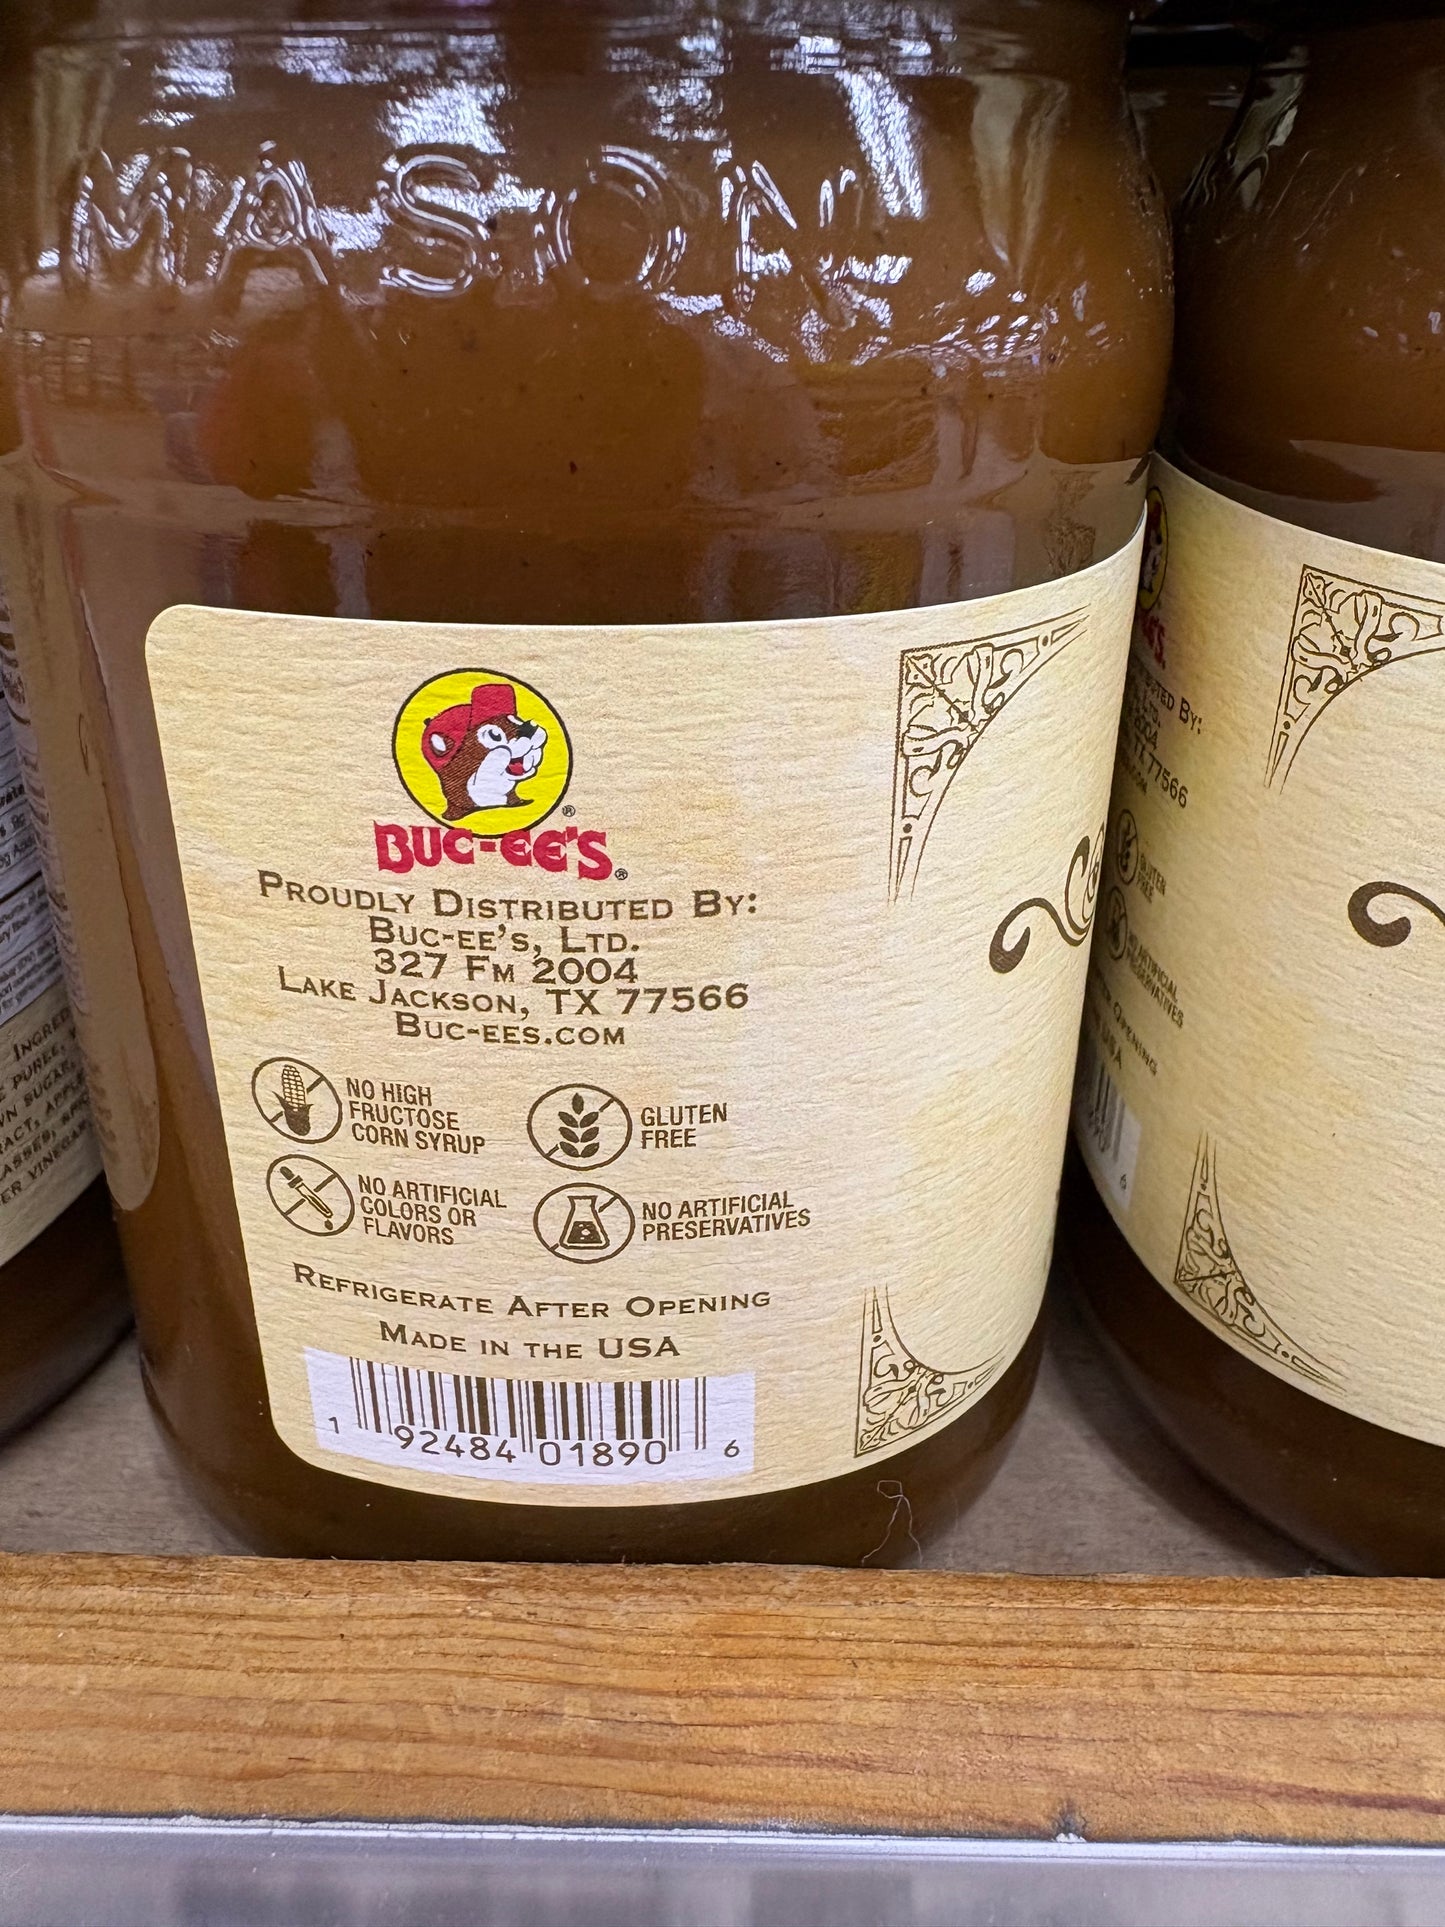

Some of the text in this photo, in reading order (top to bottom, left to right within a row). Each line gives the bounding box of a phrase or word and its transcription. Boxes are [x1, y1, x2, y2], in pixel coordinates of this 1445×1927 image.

[1148, 752, 1188, 809] 77566
[693, 889, 757, 918] BY:
[369, 916, 639, 958] BUC-EE'S, LTD.
[374, 948, 638, 985] 327 FM 2004
[277, 966, 749, 1021] LAKE JACKSON, TX 77566
[395, 1011, 625, 1046] BUC-EES.COM
[346, 1078, 432, 1106] NO HIGH
[349, 1103, 460, 1131] FRUCTOSE
[640, 1103, 728, 1129] GLUTEN
[351, 1123, 486, 1155] CORN SYRUP
[641, 1129, 696, 1150] FREE
[358, 1175, 507, 1209] NO ARTIFICIAL
[642, 1191, 794, 1222] NO ARTIFICIAL
[360, 1197, 477, 1228] COLORS OR
[642, 1209, 811, 1243] PRESERVATIVES
[364, 1218, 455, 1246] FLAVORS
[293, 1262, 771, 1319] REFRIGERATE AFTER OPENING
[379, 1320, 681, 1360] MADE IN THE USA
[328, 1416, 741, 1467] 1 92484 01890 6
